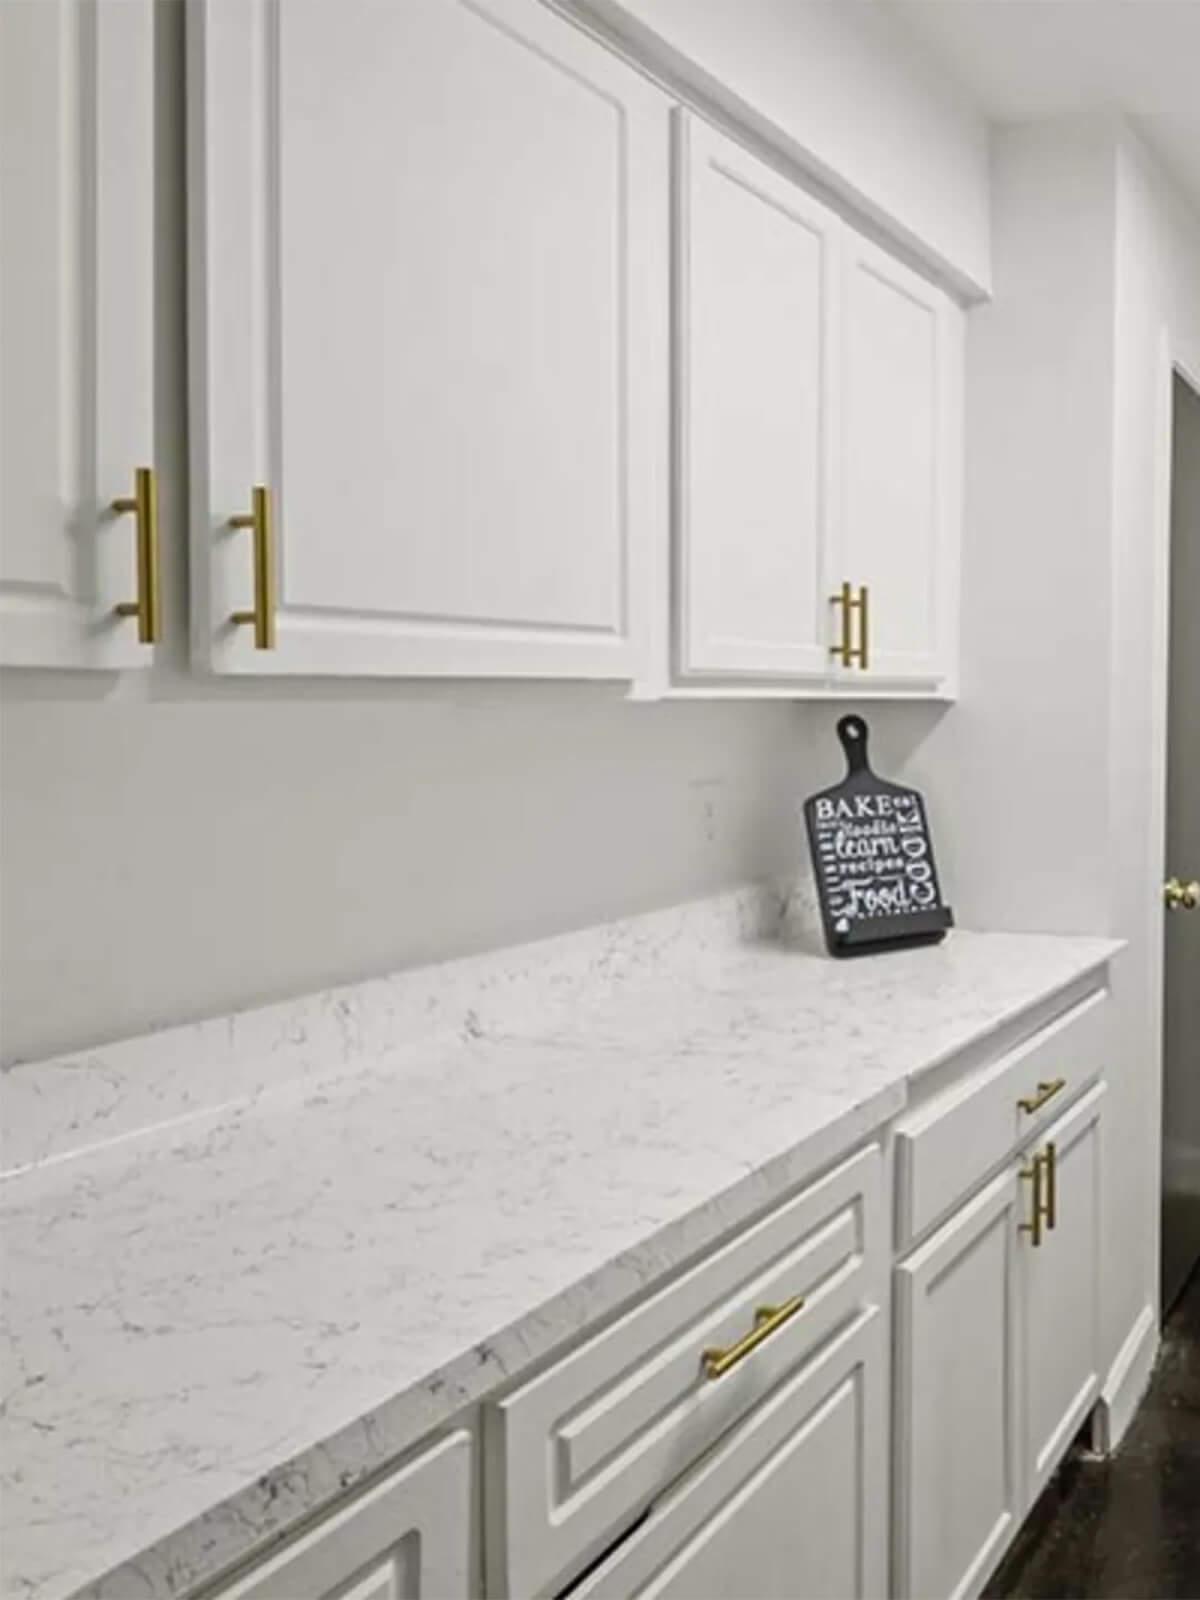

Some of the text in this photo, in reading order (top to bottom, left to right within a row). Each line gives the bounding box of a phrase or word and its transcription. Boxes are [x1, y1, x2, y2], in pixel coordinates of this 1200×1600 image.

[816, 794, 894, 819] BAKE
[835, 831, 900, 859] learn
[840, 873, 911, 917] Food
